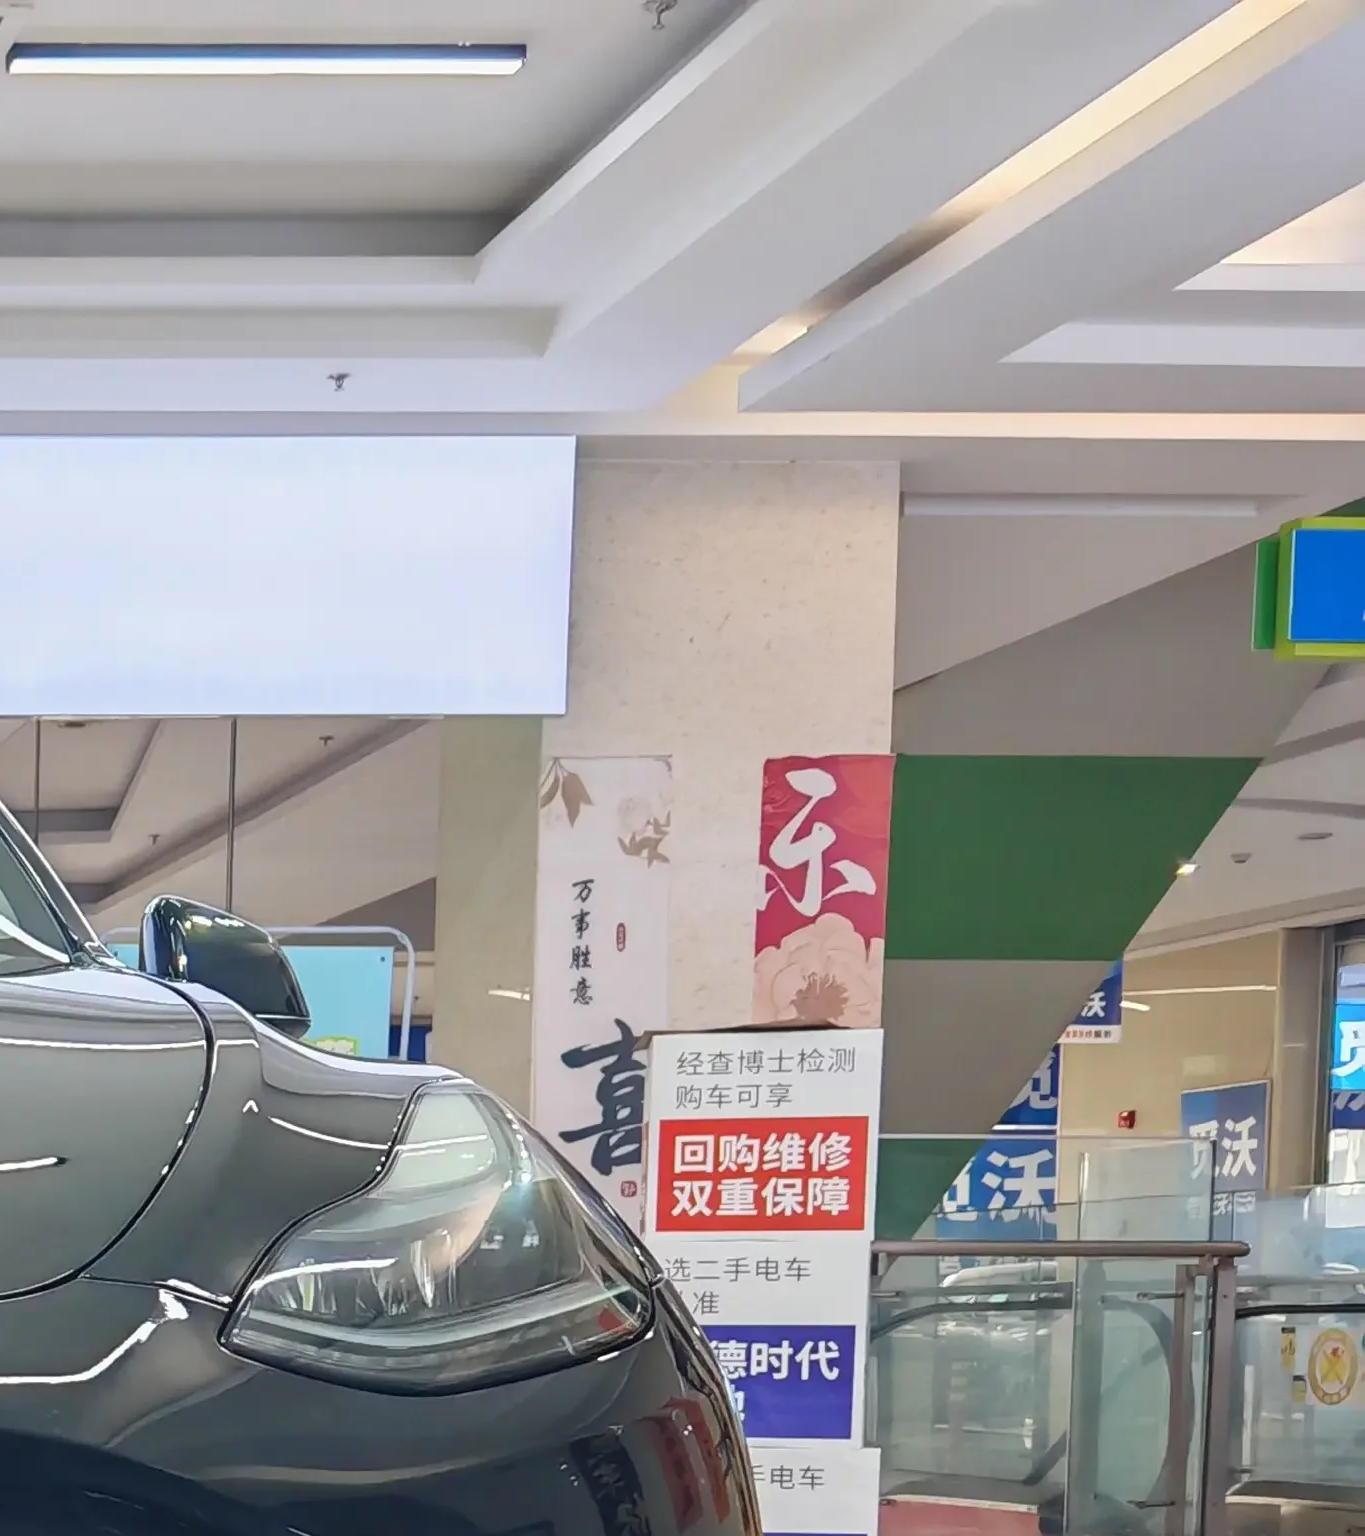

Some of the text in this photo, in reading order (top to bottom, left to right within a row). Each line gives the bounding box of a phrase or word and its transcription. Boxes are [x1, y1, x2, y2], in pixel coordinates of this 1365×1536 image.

[568, 878, 595, 1006] 万事胜意
[676, 1047, 857, 1077] 经查博士检测
[675, 1083, 794, 1110] 购车可享
[672, 1132, 853, 1174] 回购维修
[671, 1176, 851, 1218] 双重保障
[665, 1257, 812, 1283] 选二手电车
[679, 1290, 721, 1316] 准
[708, 1340, 841, 1382] 德时代
